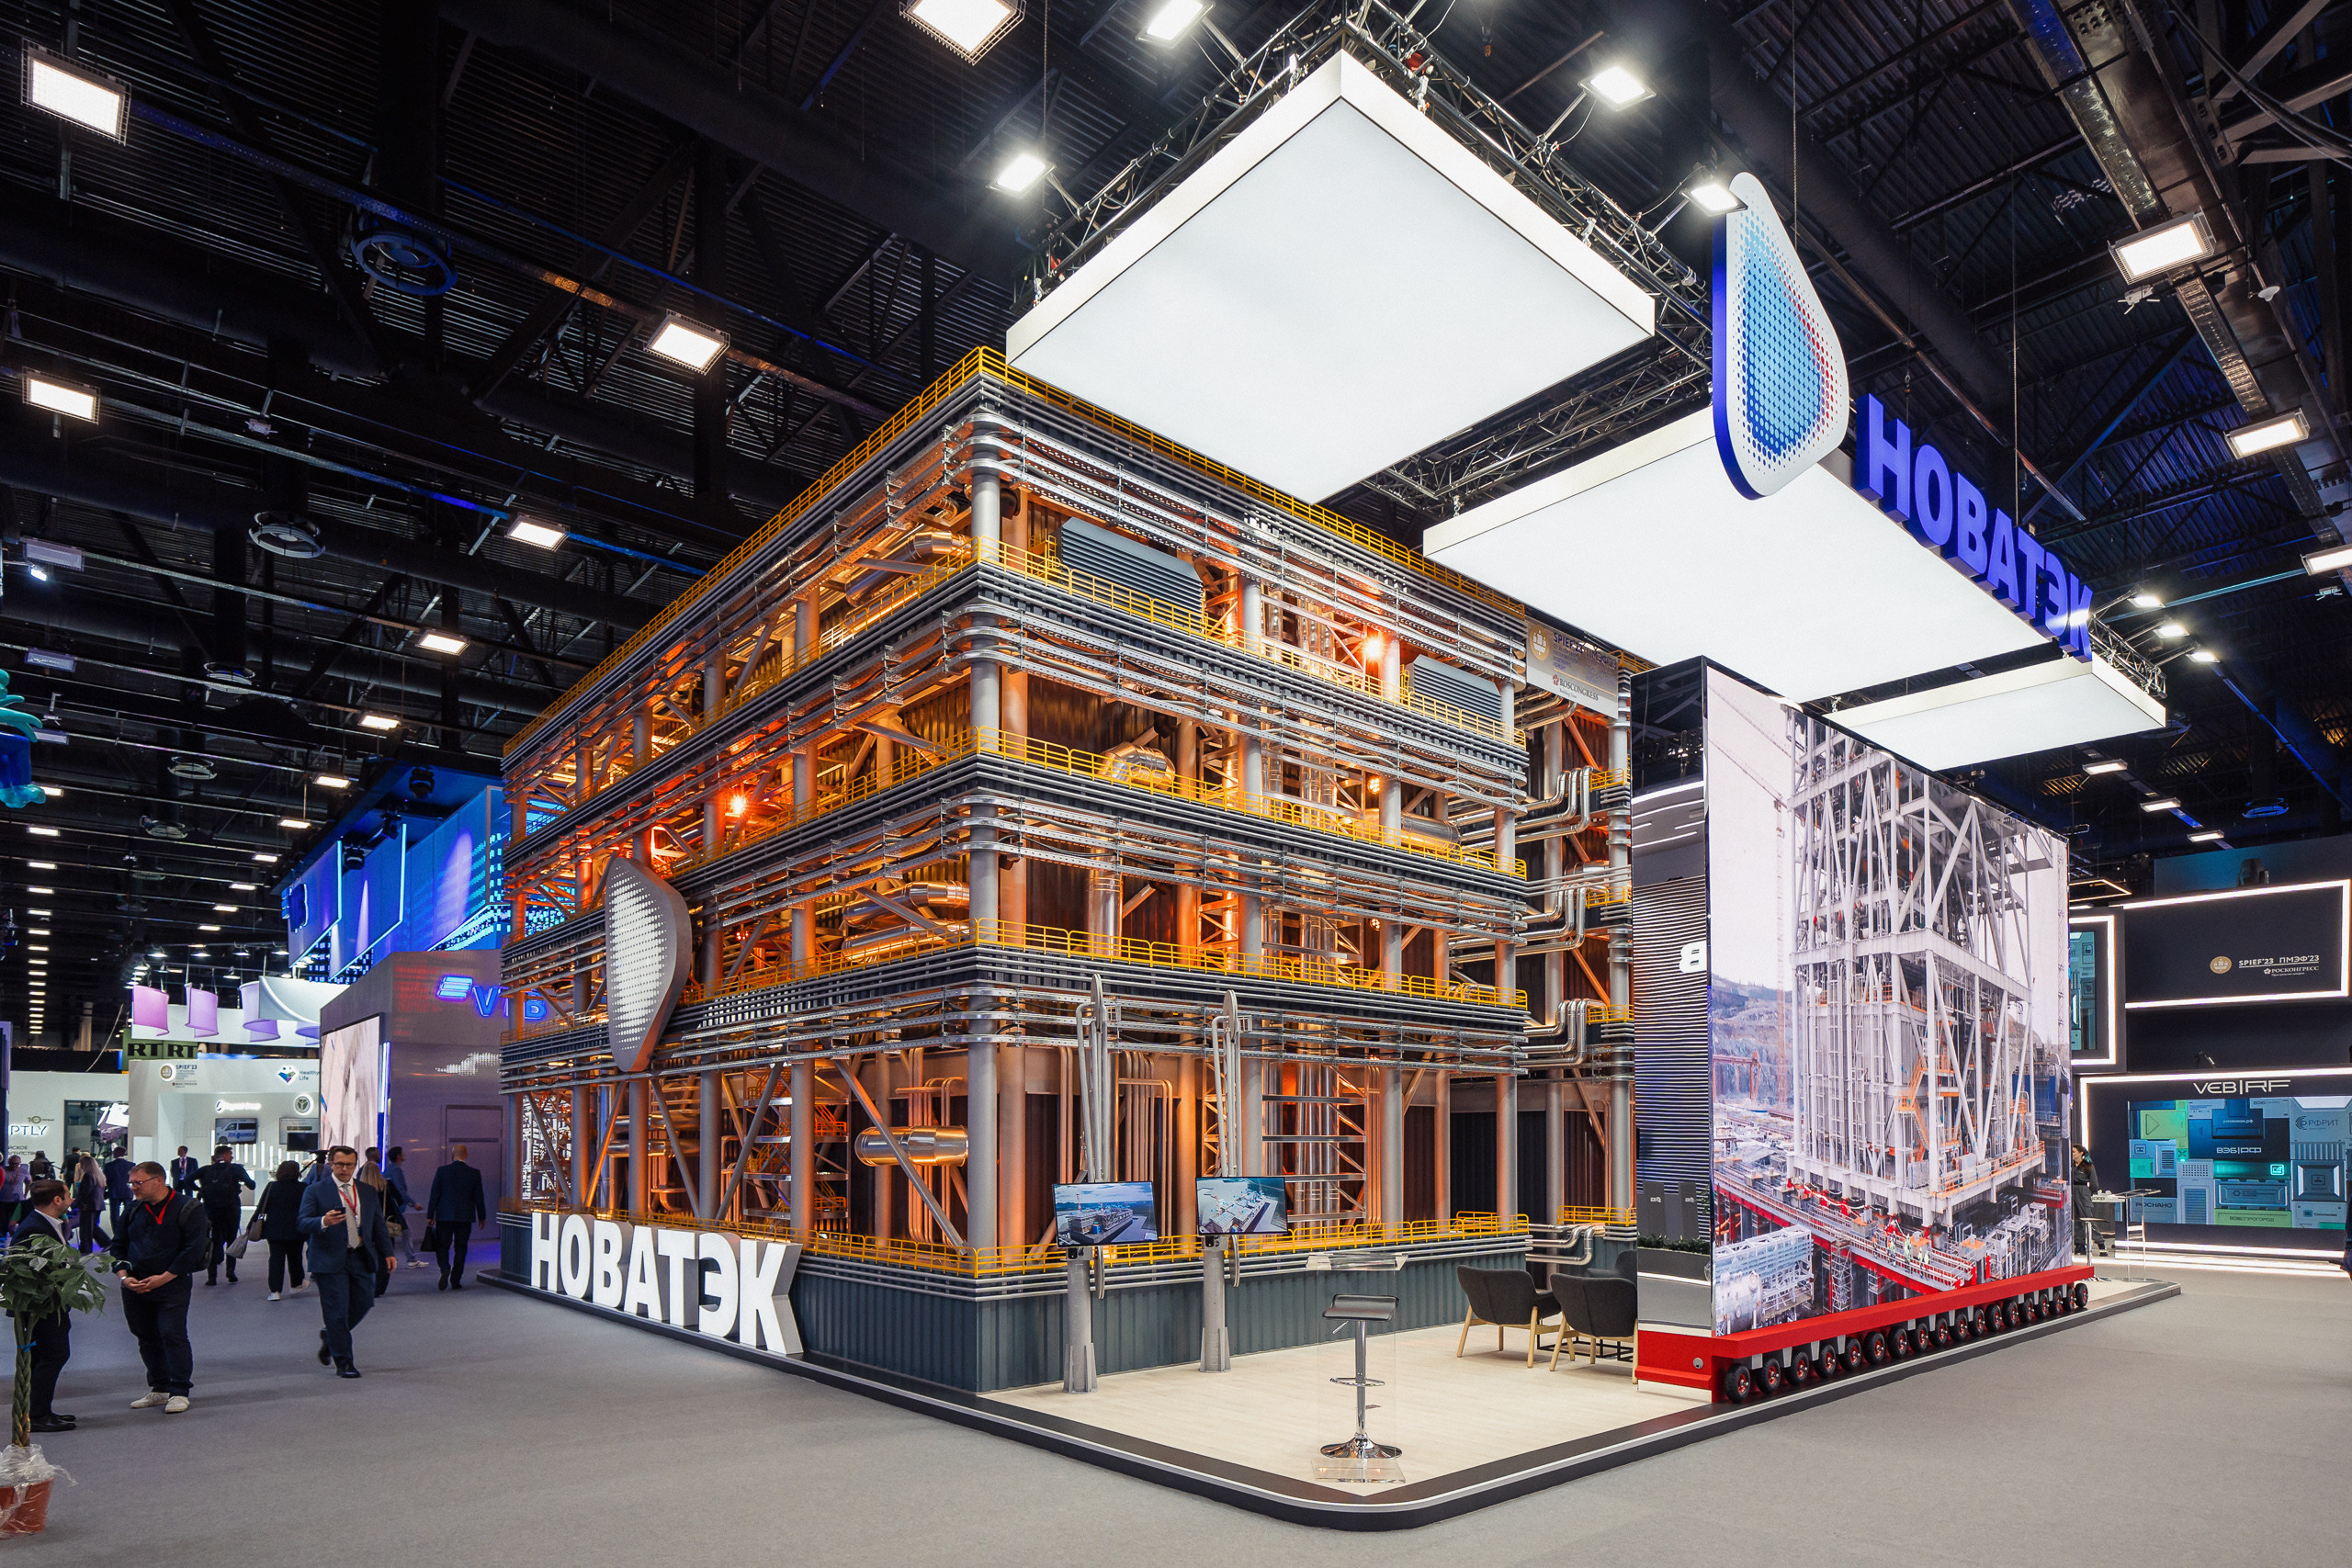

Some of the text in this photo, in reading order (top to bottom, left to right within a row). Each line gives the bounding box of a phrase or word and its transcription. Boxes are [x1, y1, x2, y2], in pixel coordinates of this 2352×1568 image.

[1860, 393, 2094, 662] НОВАТЭК
[2239, 955, 2320, 966] SPIEF'23 ПМЭФ'23
[2272, 965, 2320, 974] РОСКОНГРЕСС
[128, 1043, 163, 1056] RT
[168, 1043, 198, 1058] RT
[531, 1213, 803, 1355] НОВАТЭК
